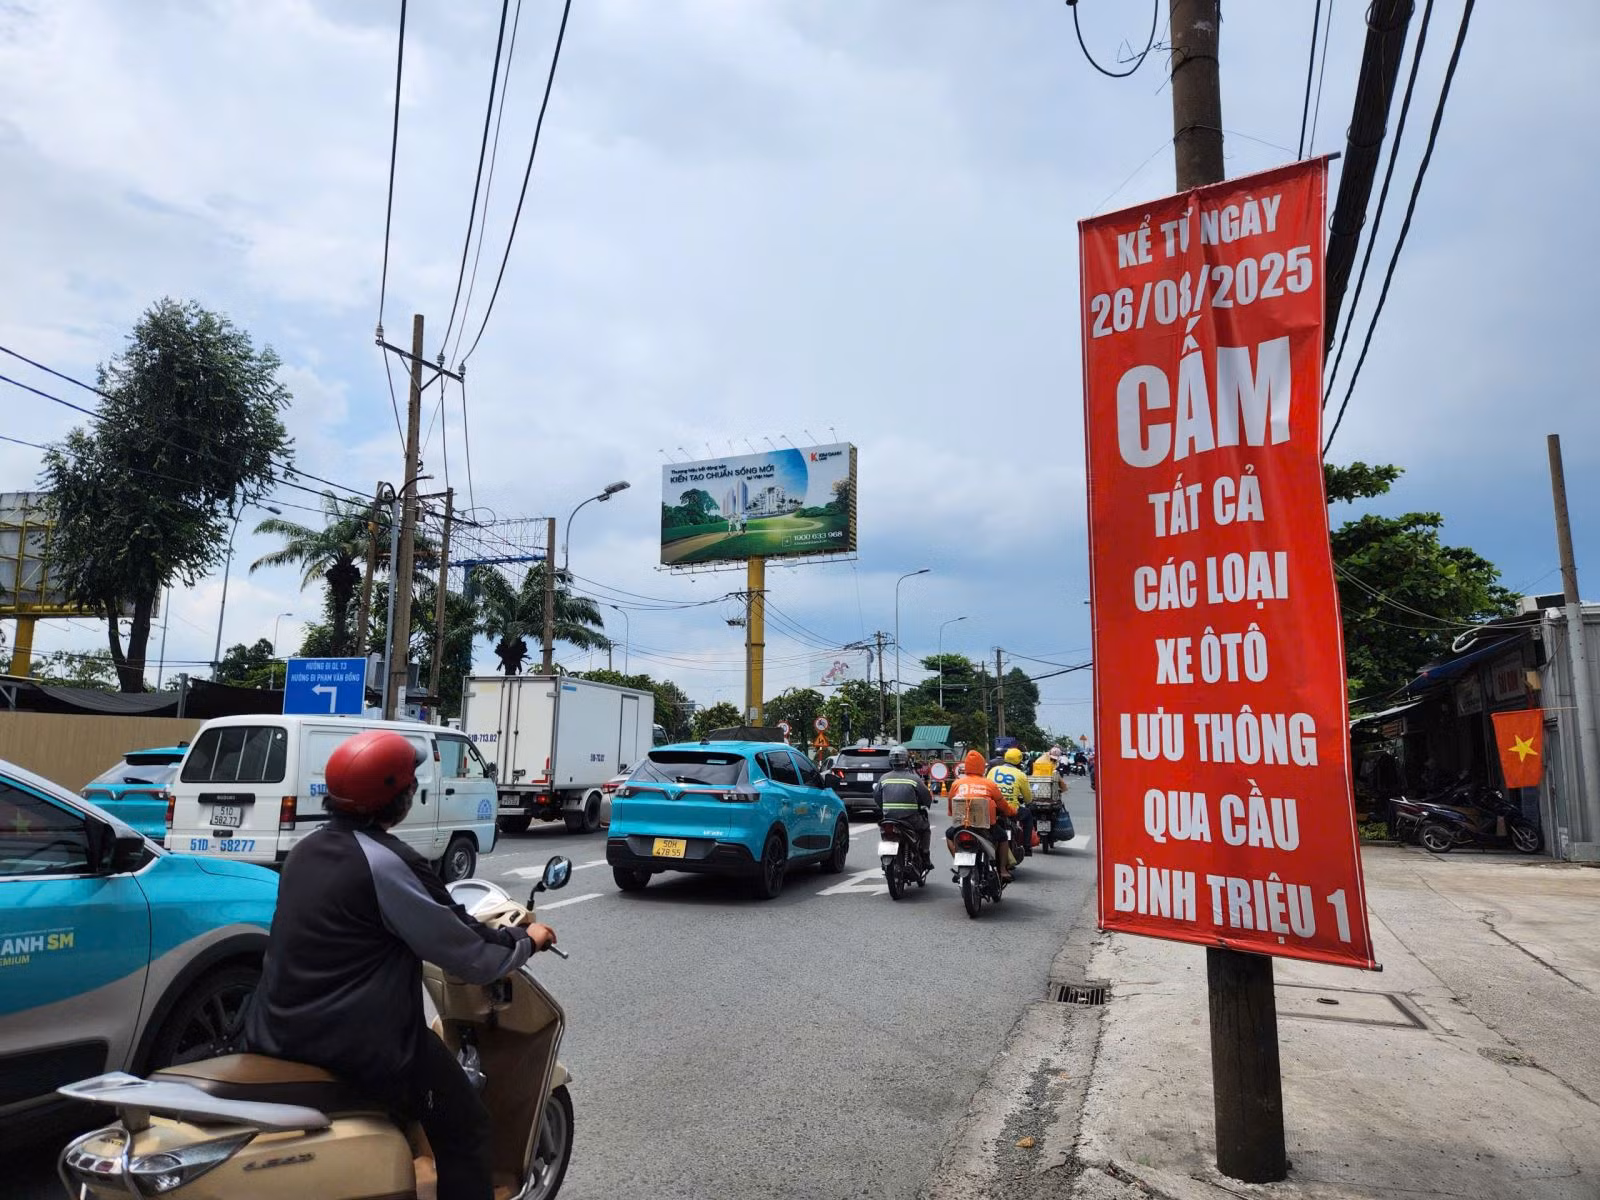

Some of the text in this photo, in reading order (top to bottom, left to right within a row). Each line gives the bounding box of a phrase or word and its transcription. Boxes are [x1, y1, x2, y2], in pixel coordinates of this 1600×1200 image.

[1117, 194, 1281, 269] KỂ TỪ NGÀY
[1091, 245, 1313, 339] 26/08/2025
[1116, 314, 1291, 468] CẤM
[670, 463, 775, 484] KIẾN TẠO CHUẨN SỐNG MỚI
[1148, 464, 1264, 538] TẤT CẢ
[1134, 551, 1289, 612] CÁC LOẠI
[344, 671, 360, 682] ĐỒNG
[1155, 622, 1268, 685] XE ÔTÔ
[1119, 704, 1319, 766] LƯU THÔNG
[994, 769, 1015, 785] be
[190, 838, 209, 851] 51D
[220, 839, 256, 852] 58277
[1143, 778, 1300, 852] QUA CẦU
[1113, 858, 1351, 944] BÌNH TRIỆU 1
[0, 935, 44, 956] ANH
[47, 932, 74, 950] SM
[0, 954, 30, 967] EMIUM
